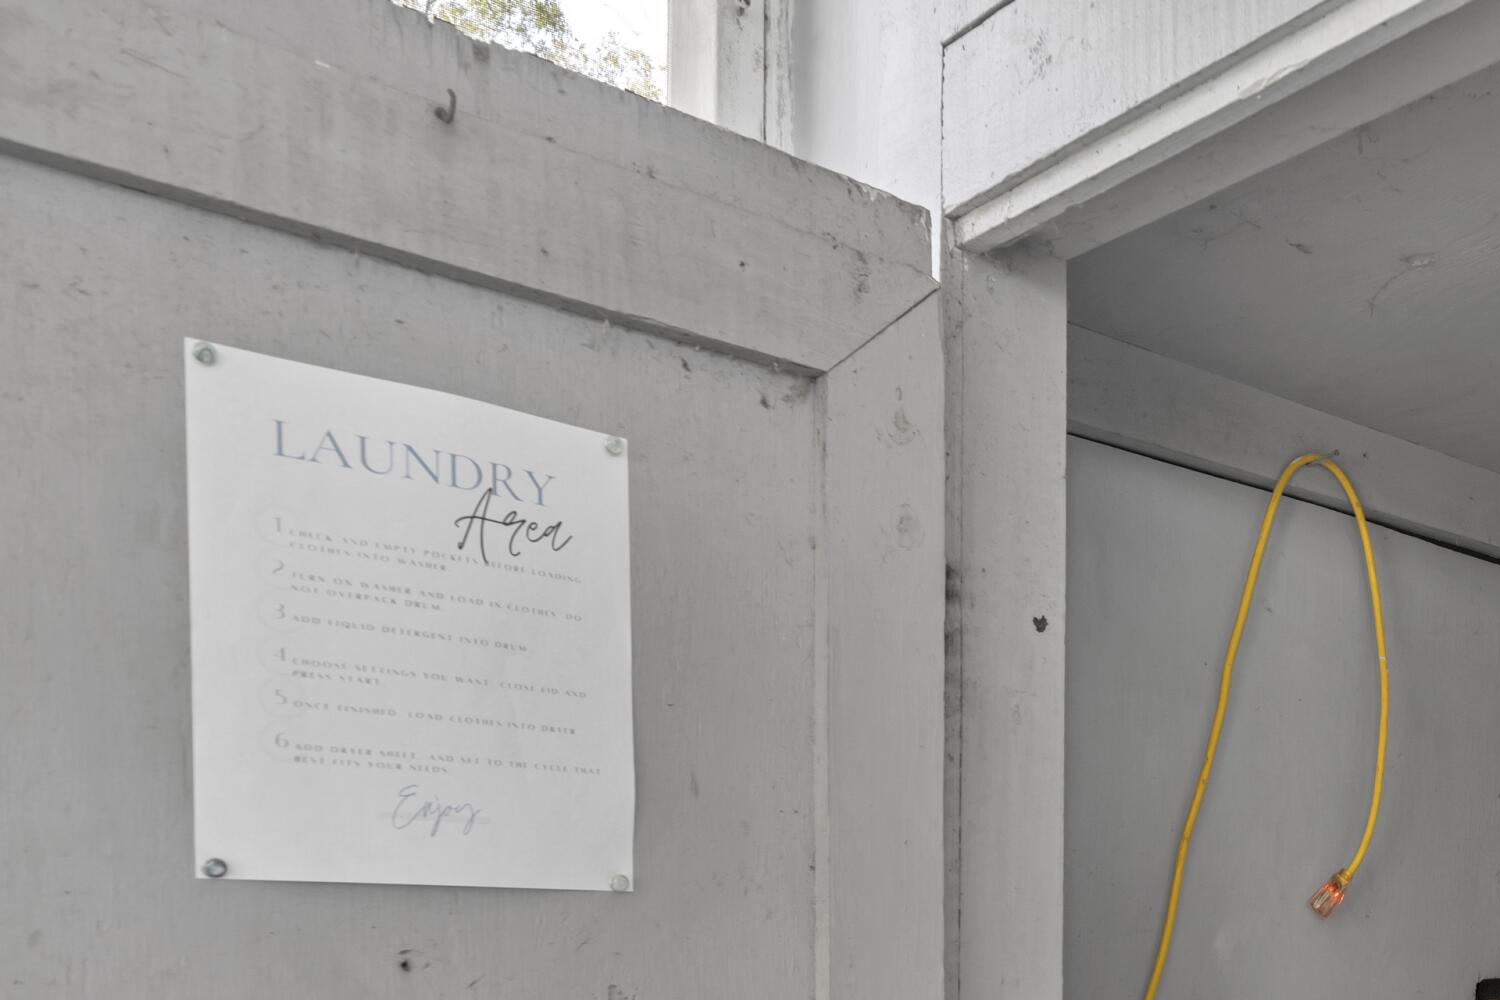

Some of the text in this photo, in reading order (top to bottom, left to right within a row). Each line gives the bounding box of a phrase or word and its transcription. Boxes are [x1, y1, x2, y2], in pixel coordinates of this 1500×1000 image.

[271, 418, 556, 507] LAUNDRY
[272, 516, 282, 533] 1
[342, 537, 369, 547] AND
[423, 549, 479, 565] POCKETS
[530, 568, 583, 585] LOADING
[454, 487, 573, 565] Area
[272, 559, 285, 575] 2
[332, 577, 353, 587] ON
[419, 590, 445, 600] AND
[450, 594, 484, 606] LOAD
[489, 600, 502, 609] IN
[565, 613, 583, 622] DO
[274, 602, 286, 619] 3
[293, 614, 322, 625] ADD
[327, 619, 375, 632] LIQUID
[381, 625, 453, 642] DETERGENT
[459, 635, 490, 647] INTO
[273, 647, 286, 662] 4
[423, 671, 448, 682] YOU
[499, 681, 534, 692] CLOSE
[540, 687, 559, 695] LID
[565, 690, 587, 699] AND
[274, 688, 288, 705] 5
[293, 700, 329, 711] ONCE
[407, 711, 443, 721] LOAD
[507, 721, 536, 731] INTO
[274, 731, 290, 749] 6
[295, 744, 323, 752] ADD
[330, 746, 372, 756] DRYER
[429, 754, 454, 763] AND
[460, 757, 479, 765] SET
[487, 758, 503, 767] TO
[509, 761, 528, 770] THE
[574, 766, 601, 776] THAT
[367, 761, 402, 771] YOUR
[392, 784, 483, 838] Enjoy
